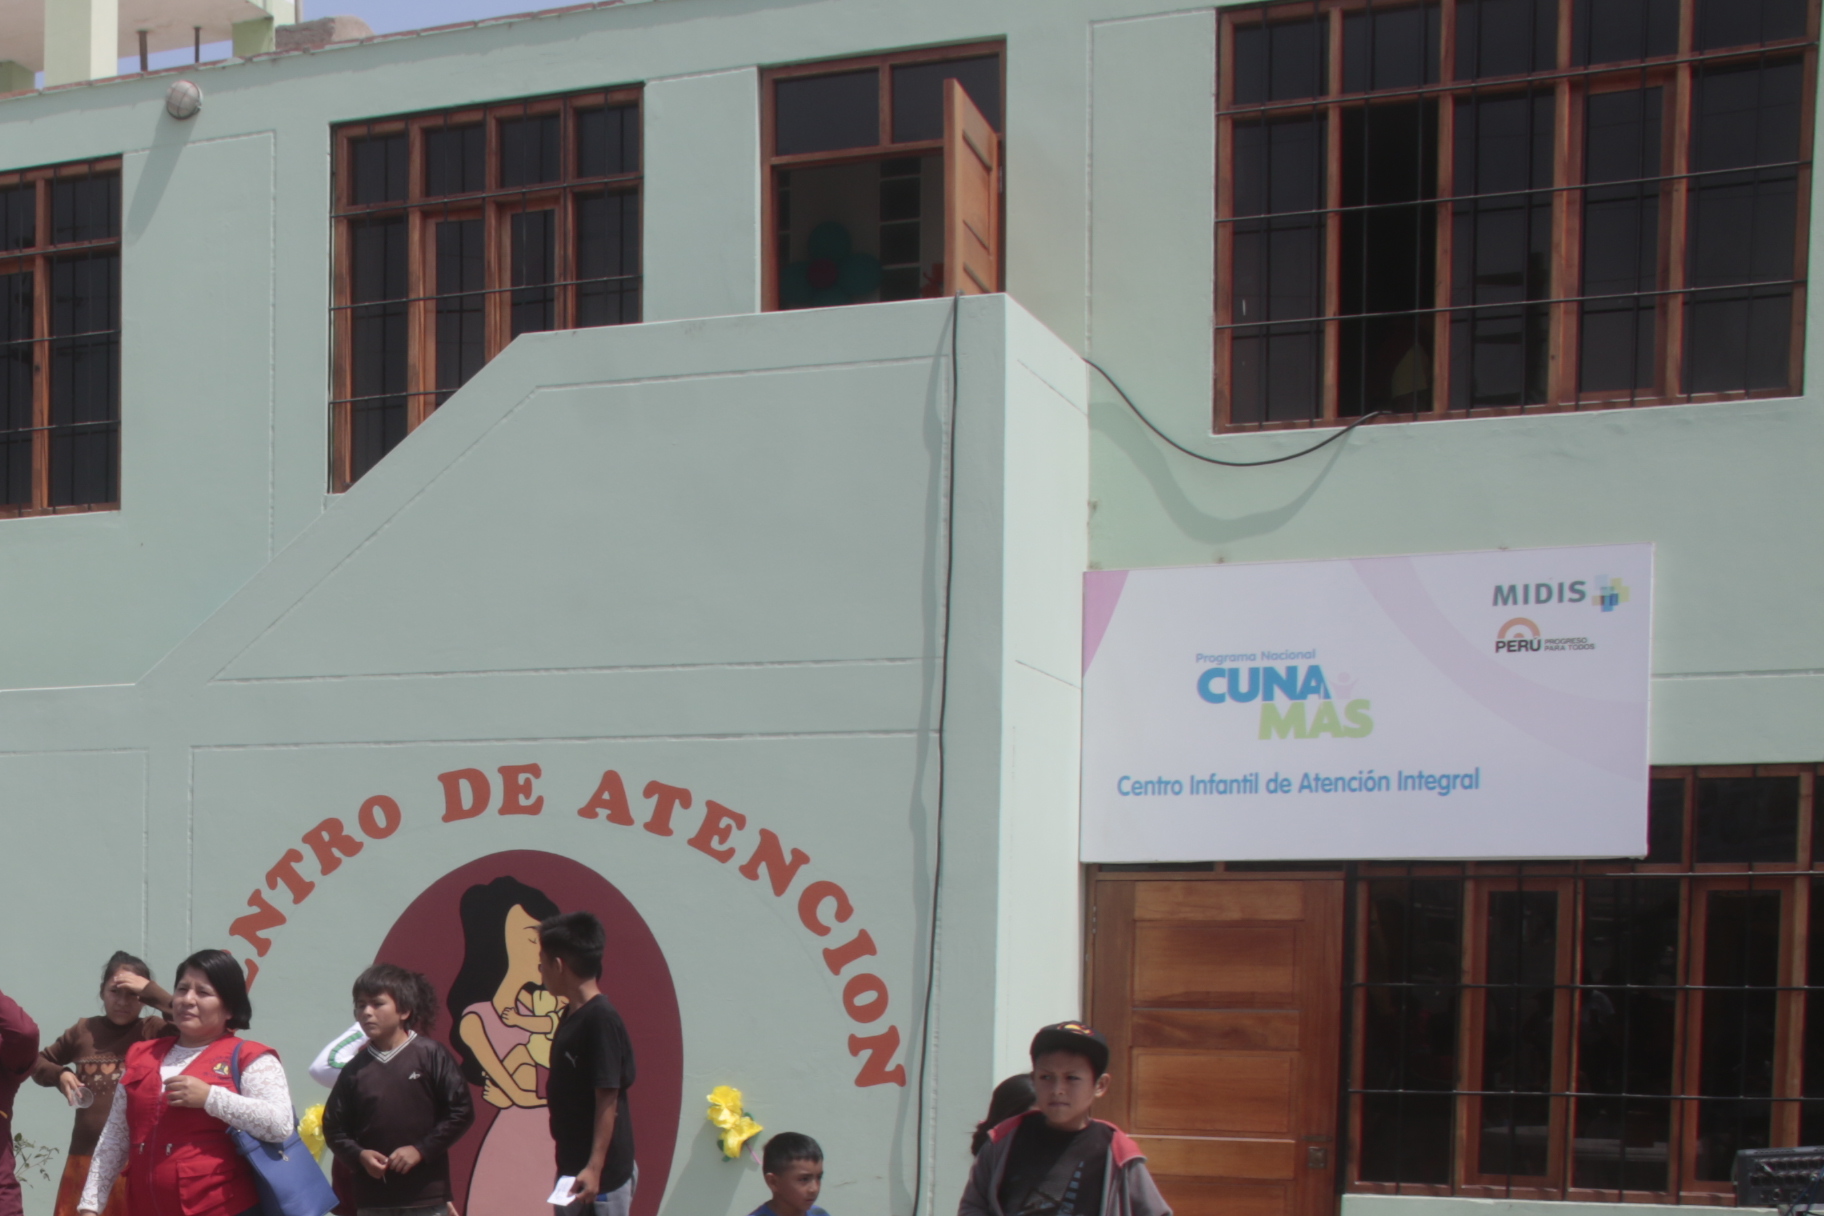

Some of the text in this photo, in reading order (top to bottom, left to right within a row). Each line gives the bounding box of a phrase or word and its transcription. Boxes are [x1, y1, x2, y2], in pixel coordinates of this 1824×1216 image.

[1492, 581, 1587, 606] MIDIS
[1196, 649, 1316, 666] Programa Nacional
[1495, 637, 1541, 653] PERÚ
[1197, 665, 1332, 704] CUNA
[1117, 767, 1480, 797] Centro Infantil de Atención Integral
[220, 762, 907, 1088] NTRO DE ATENCION
